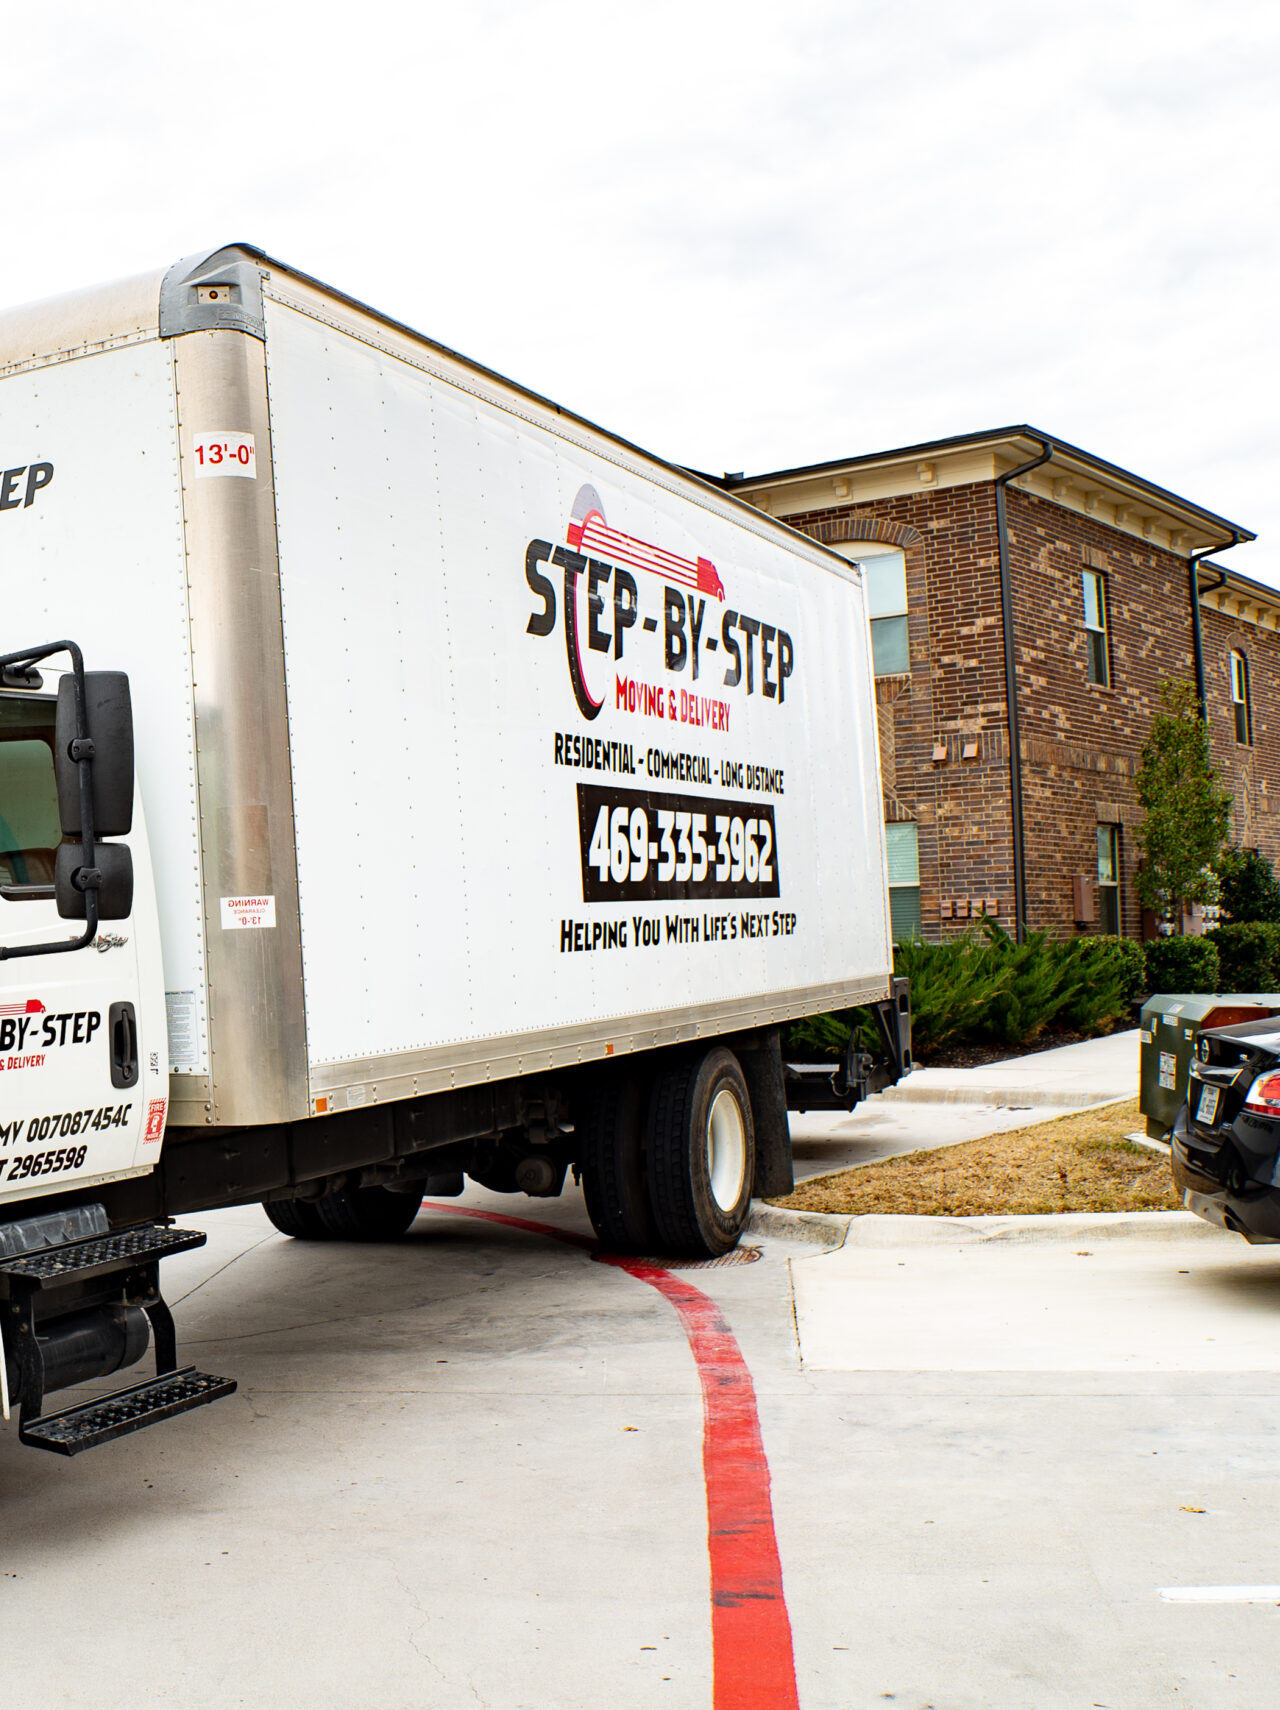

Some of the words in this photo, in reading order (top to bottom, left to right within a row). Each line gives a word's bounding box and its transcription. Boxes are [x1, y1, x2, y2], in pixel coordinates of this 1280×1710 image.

[195, 443, 254, 465] 13'-0"
[525, 538, 794, 721] STEP-BY-STEP
[616, 672, 664, 719] MOVING
[669, 689, 677, 721] &
[680, 688, 731, 732] DELIVERY
[554, 732, 636, 774] RESIDENTIAL
[647, 747, 712, 784] COMMERCIAL
[721, 759, 744, 789] LONG
[746, 763, 785, 795] DISTANCE
[588, 804, 773, 883] 469-335-3962
[560, 919, 628, 952] HELPING
[632, 916, 661, 947] YOU
[665, 914, 700, 944] WITH
[703, 912, 737, 941] LIFE'S
[740, 912, 770, 938] NEXT
[771, 911, 797, 936] STEP
[7, 1054, 46, 1070] DELIVERY
[26, 1103, 133, 1143] 007087454C
[6, 1144, 88, 1182] 2965598
